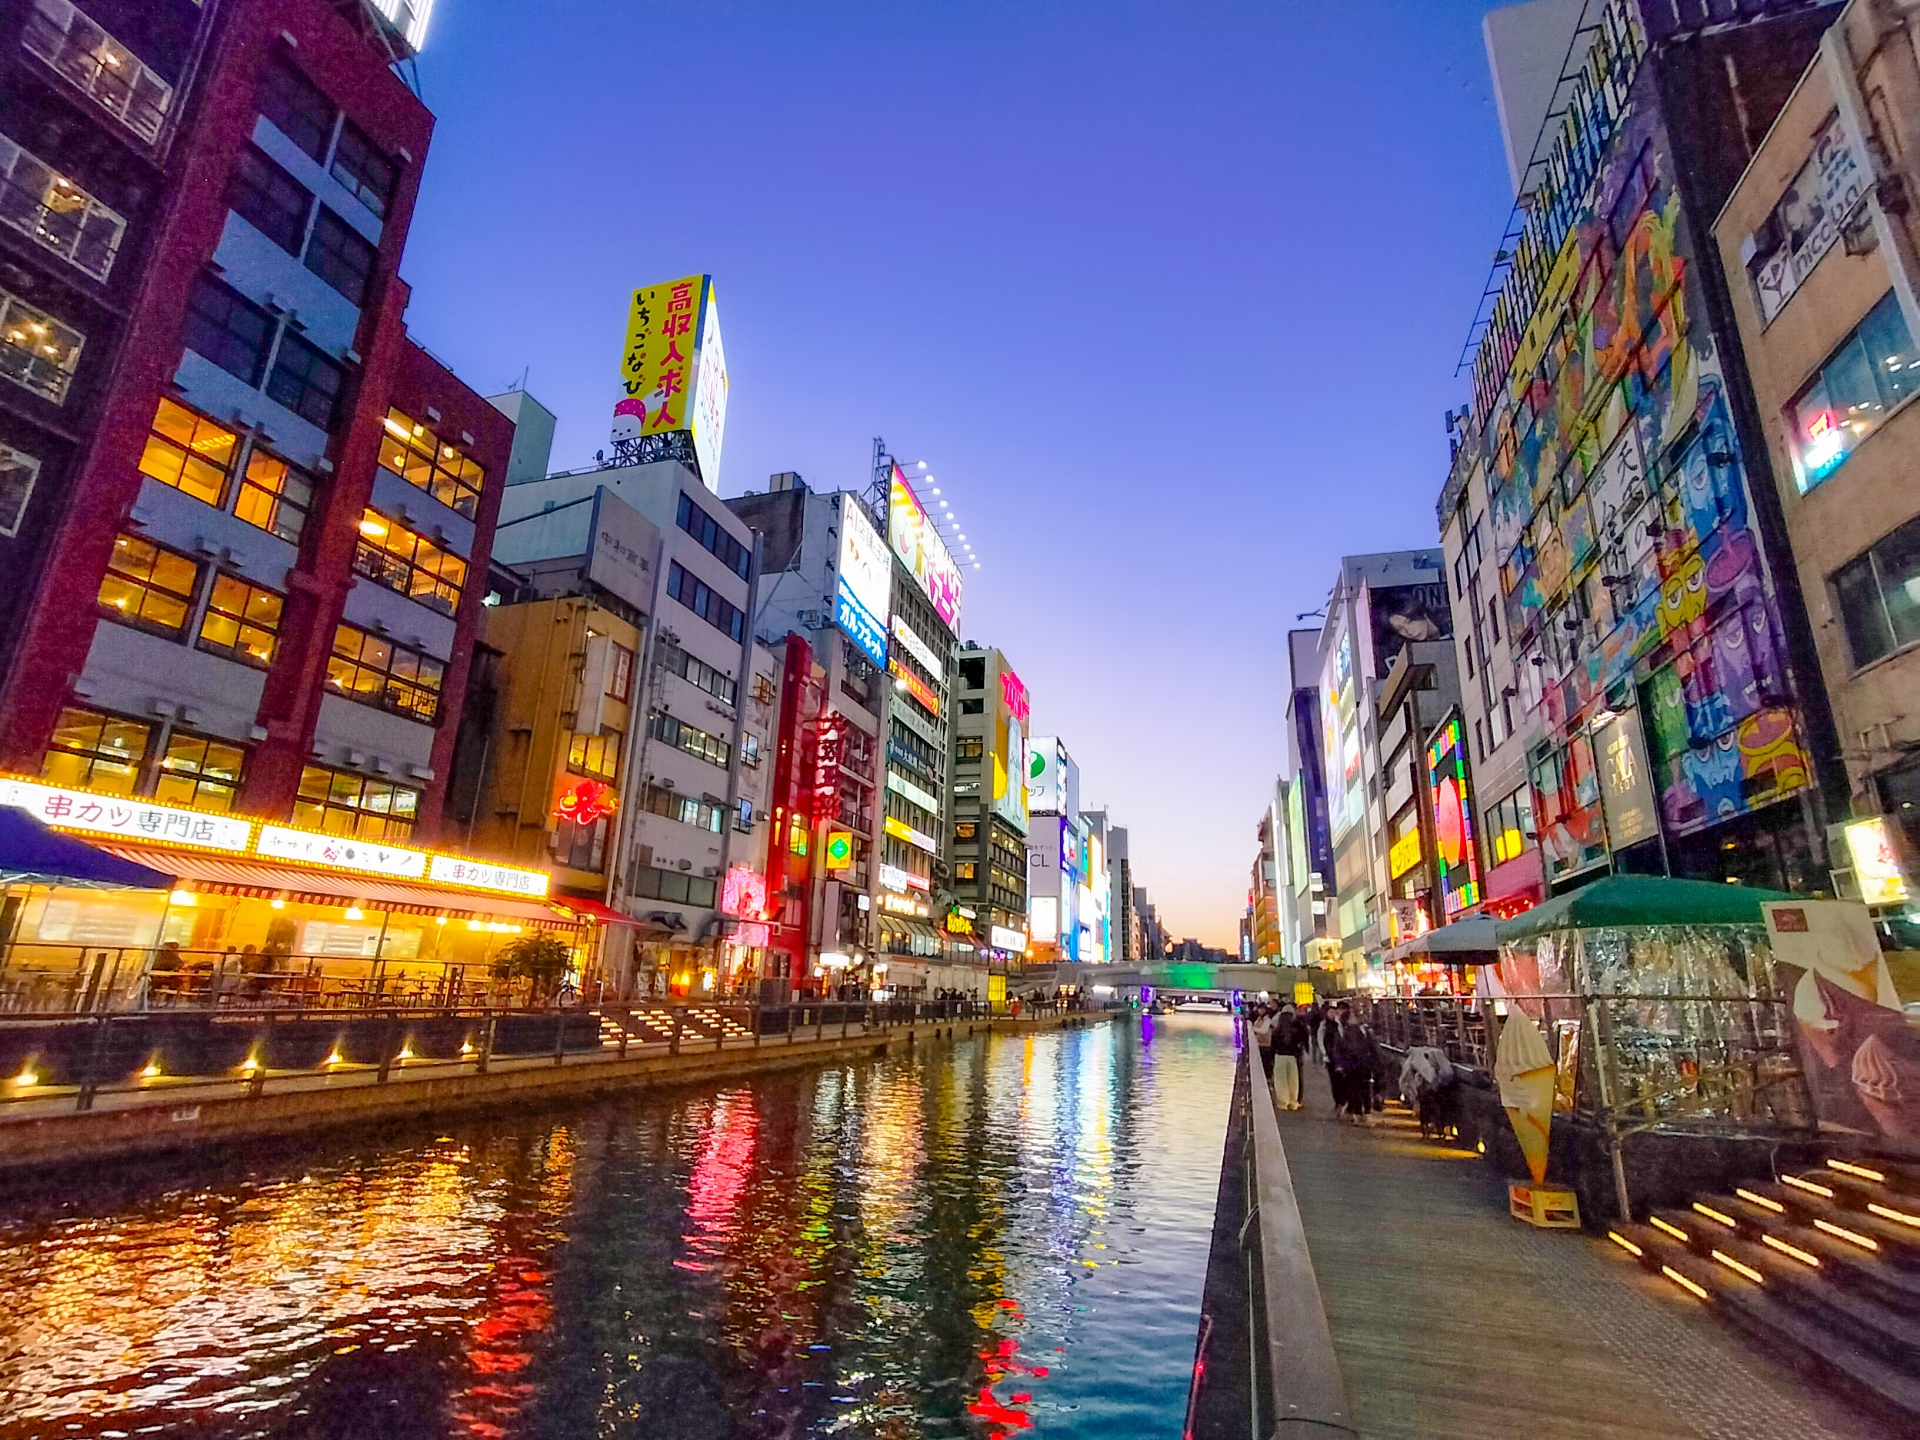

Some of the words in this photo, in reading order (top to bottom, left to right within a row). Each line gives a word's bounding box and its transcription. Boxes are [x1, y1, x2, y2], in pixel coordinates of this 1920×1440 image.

[622, 291, 655, 395] いちごなび
[652, 282, 694, 428] 高収入求人
[44, 794, 216, 842] 串カツ専門店
[453, 864, 530, 890] 串カツ専門店
